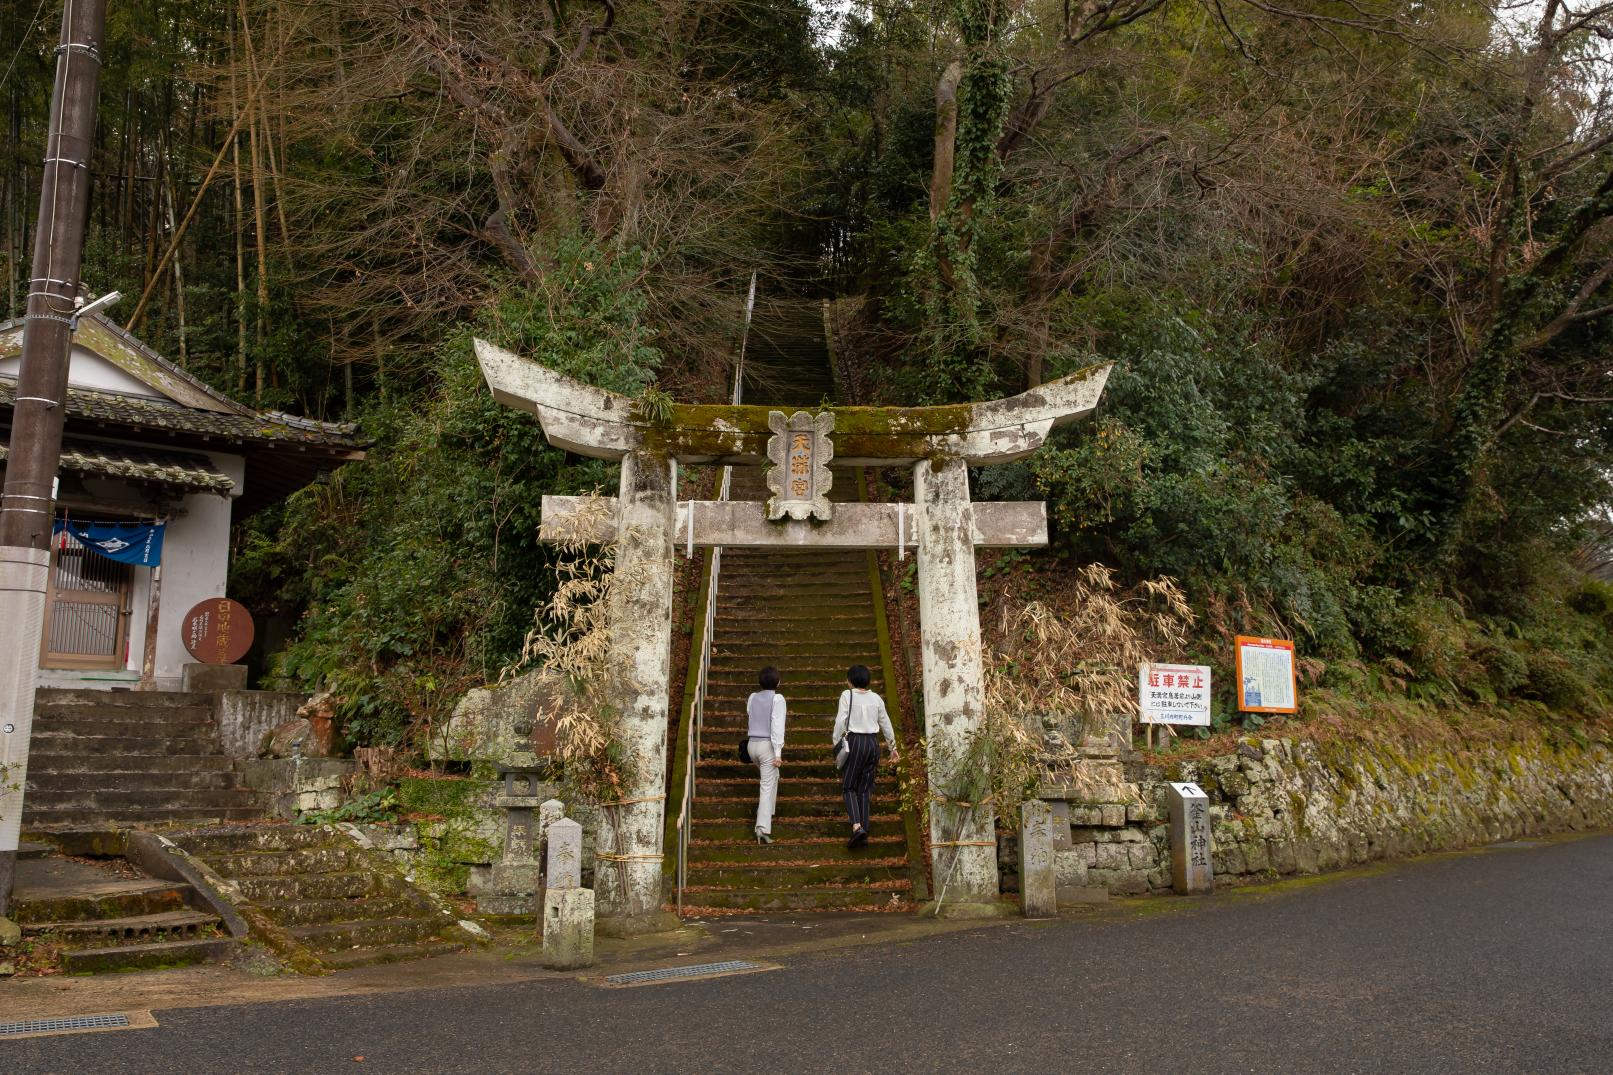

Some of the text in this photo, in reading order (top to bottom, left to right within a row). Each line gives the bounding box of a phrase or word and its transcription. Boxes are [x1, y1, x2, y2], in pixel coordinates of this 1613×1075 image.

[1148, 673, 1203, 688] 駐車禁止
[1190, 803, 1207, 866] 釜山神社
